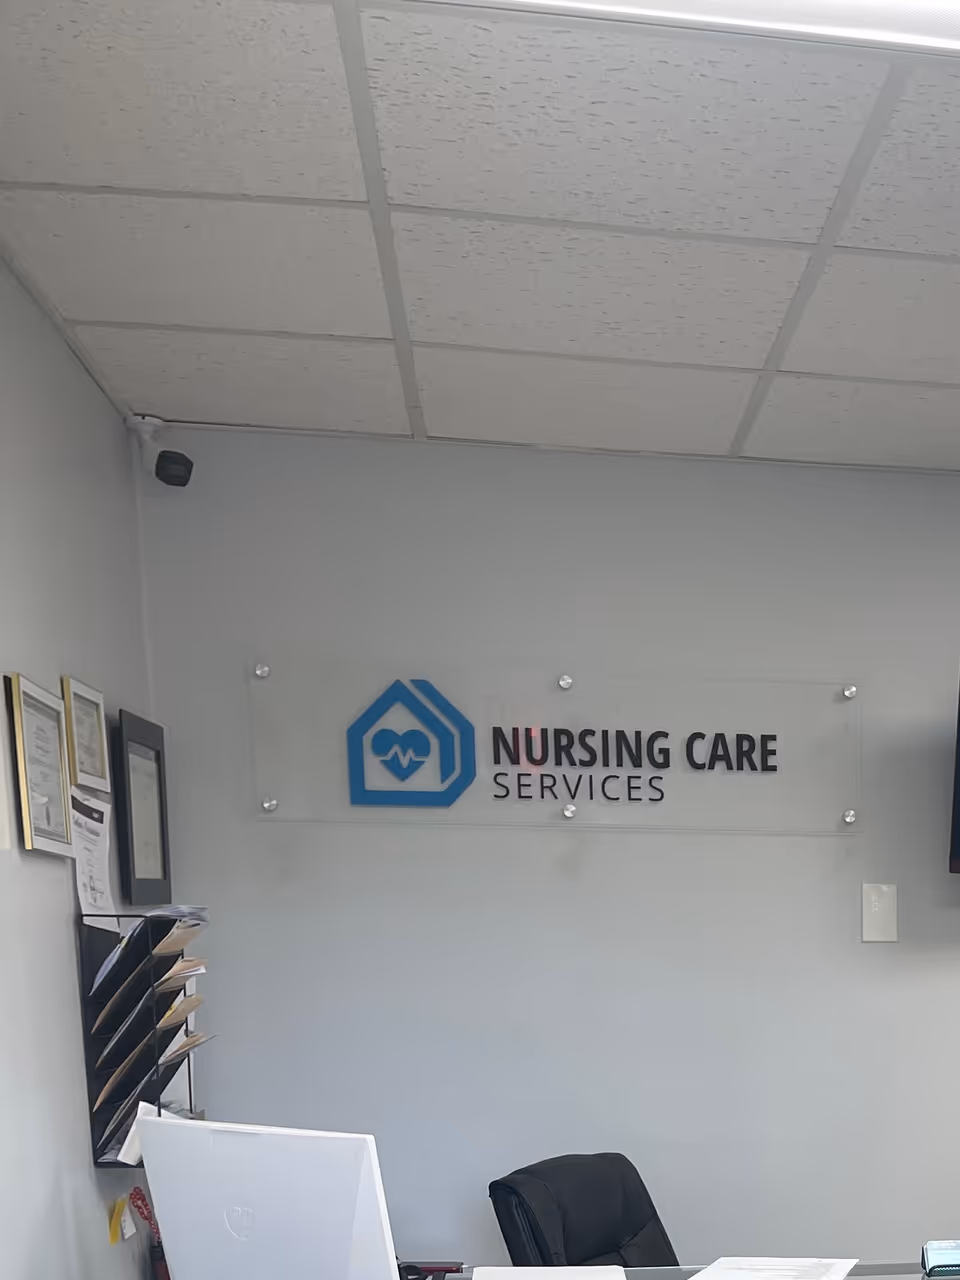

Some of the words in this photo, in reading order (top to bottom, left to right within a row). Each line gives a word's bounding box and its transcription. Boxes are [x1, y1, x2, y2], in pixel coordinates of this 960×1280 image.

[492, 727, 671, 769] NURSING
[685, 732, 778, 772] CARE
[492, 772, 665, 802] SERVICES
